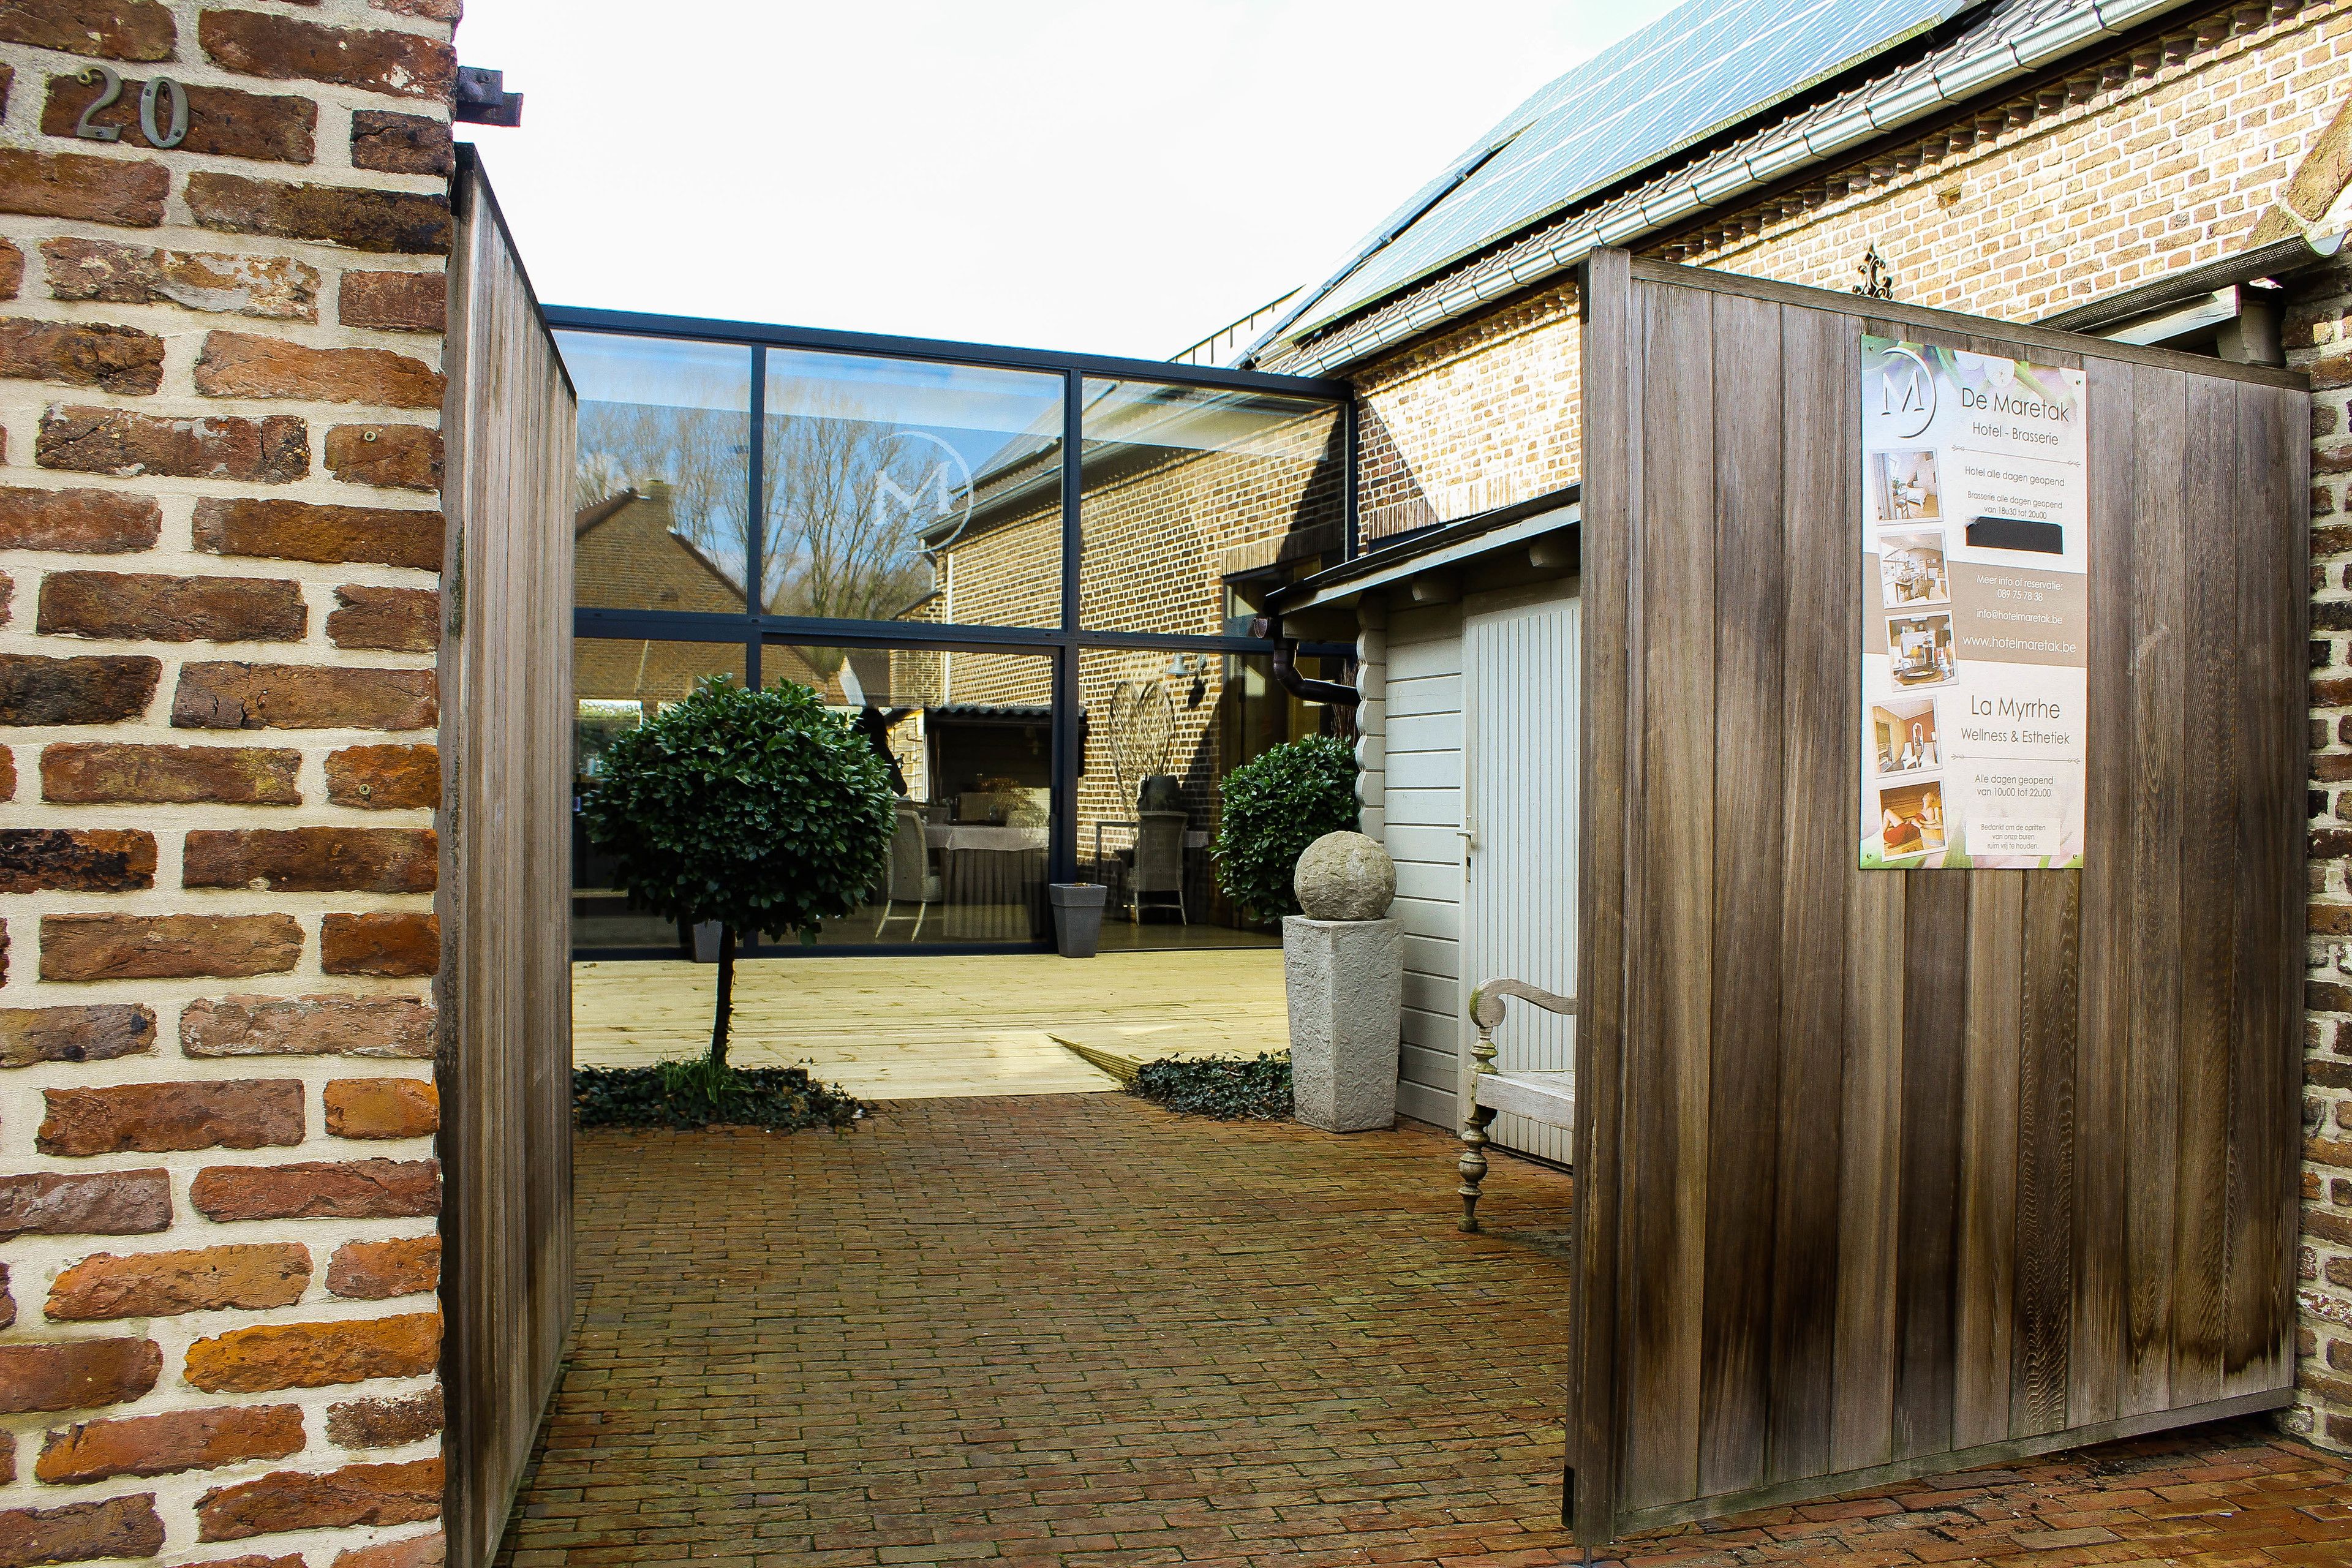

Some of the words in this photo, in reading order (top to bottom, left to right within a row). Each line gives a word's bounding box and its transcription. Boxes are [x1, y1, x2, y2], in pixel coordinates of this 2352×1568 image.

[77, 63, 188, 149] 20
[1962, 387, 1988, 410] De
[1994, 392, 2070, 423] Maretak
[1972, 421, 2002, 438] Hotel
[2012, 427, 2059, 445] Brasserie
[1965, 466, 1985, 477] Hotel
[1986, 469, 2001, 479] alle
[2002, 471, 2028, 483] dagen
[2029, 475, 2065, 487] geopend
[1967, 491, 1996, 501] Brasserie
[1996, 494, 2008, 503] alle
[2010, 496, 2032, 507] dagen
[2033, 499, 2063, 510] geopend
[1999, 506, 2017, 516] 18u30
[2028, 510, 2047, 519] 20u00
[1976, 575, 1997, 584] Meer
[1999, 576, 2013, 587] info
[2015, 578, 2023, 587] of
[2024, 579, 2064, 590] reservatie:
[1997, 589, 2011, 599] 089
[2012, 590, 2022, 600] 75
[2023, 591, 2033, 601] 78
[2034, 592, 2043, 602] 38
[1976, 608, 2063, 624] info@hotelmaretak.be
[1962, 635, 2076, 654] www.hotelmaretak.be
[1972, 695, 1992, 716] La
[1998, 696, 2060, 722] Myrrhe
[1961, 727, 2007, 742] Wellness
[2010, 729, 2019, 743] &
[2022, 729, 2070, 745] Esthetiek
[1975, 774, 1989, 783] Alle
[1991, 774, 2016, 786] dagen
[2018, 775, 2054, 786] geopend
[1994, 787, 2016, 797] 10u00
[2018, 788, 2028, 797] tot
[2029, 788, 2051, 797] 22u00
